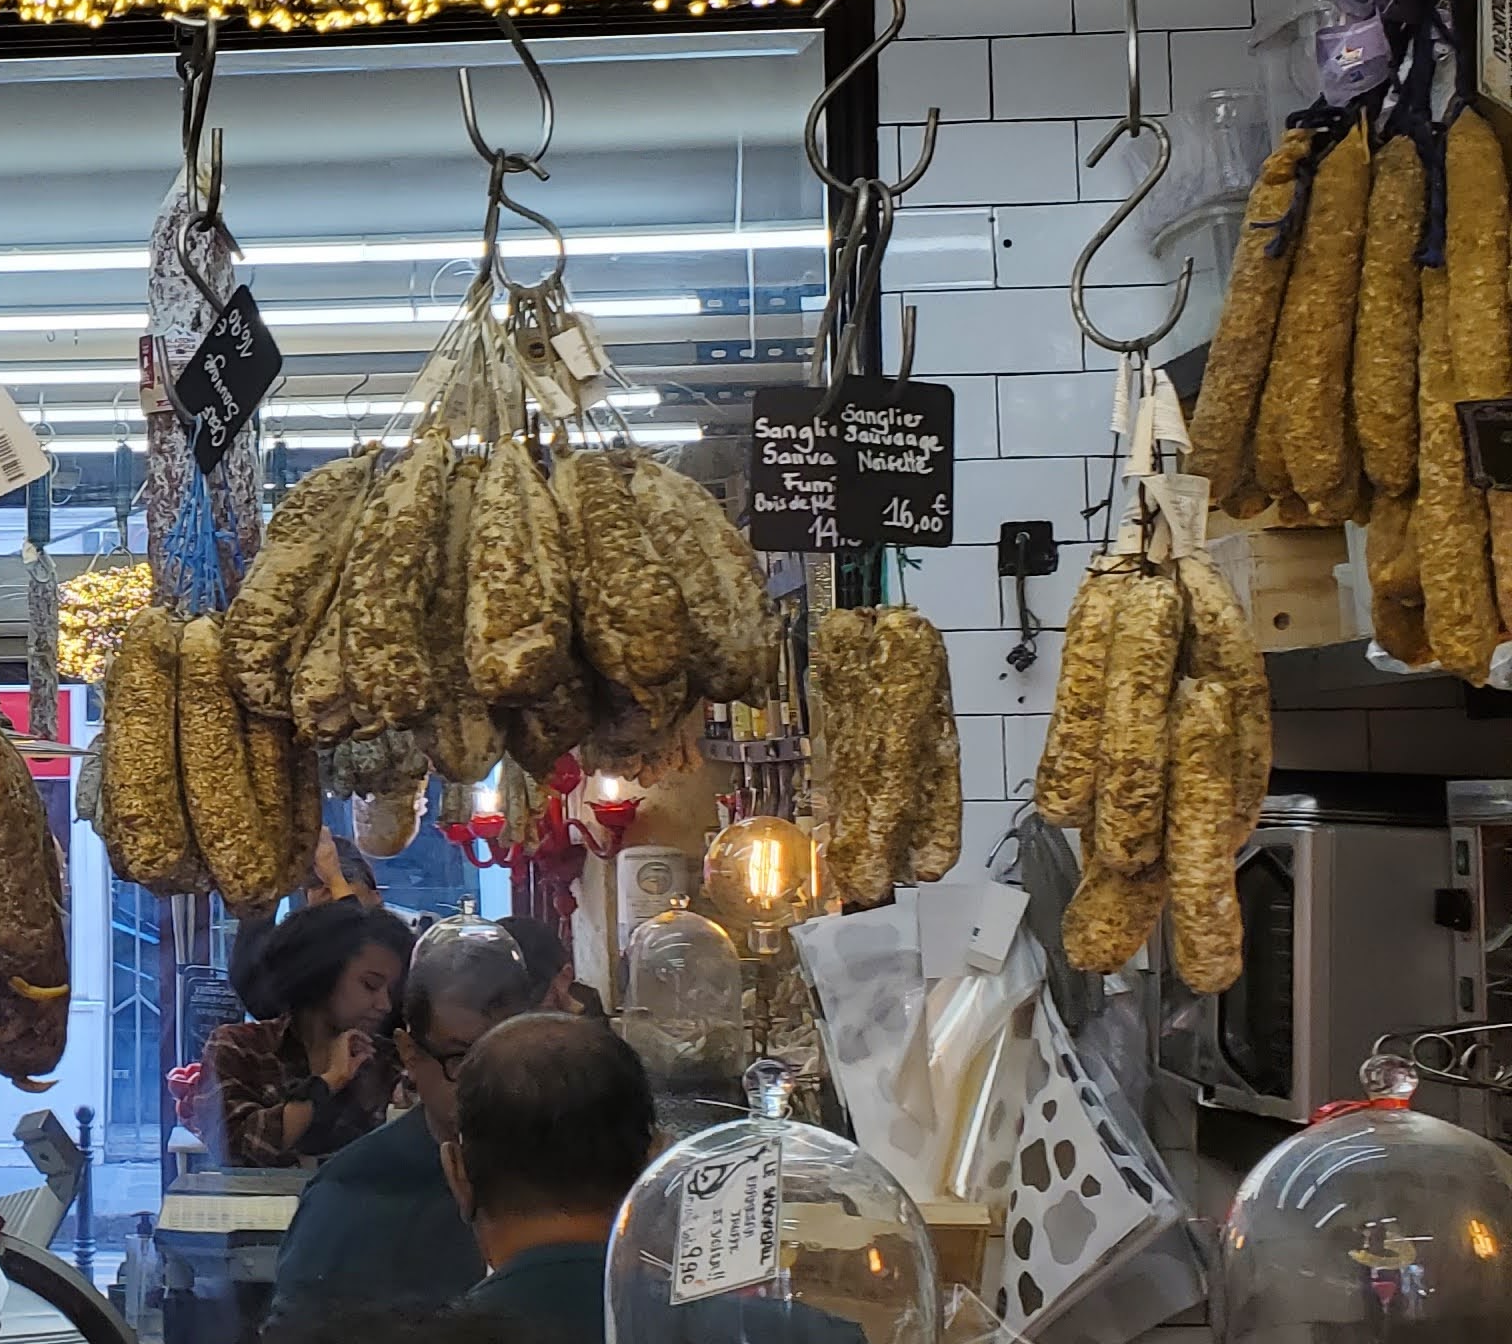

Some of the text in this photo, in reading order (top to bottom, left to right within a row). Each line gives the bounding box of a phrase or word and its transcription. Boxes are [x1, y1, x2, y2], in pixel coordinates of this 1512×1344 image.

[841, 404, 924, 434] Sanglier
[782, 472, 838, 493] Fum
[882, 497, 944, 533] 16,00
[763, 1161, 777, 1179] LE
